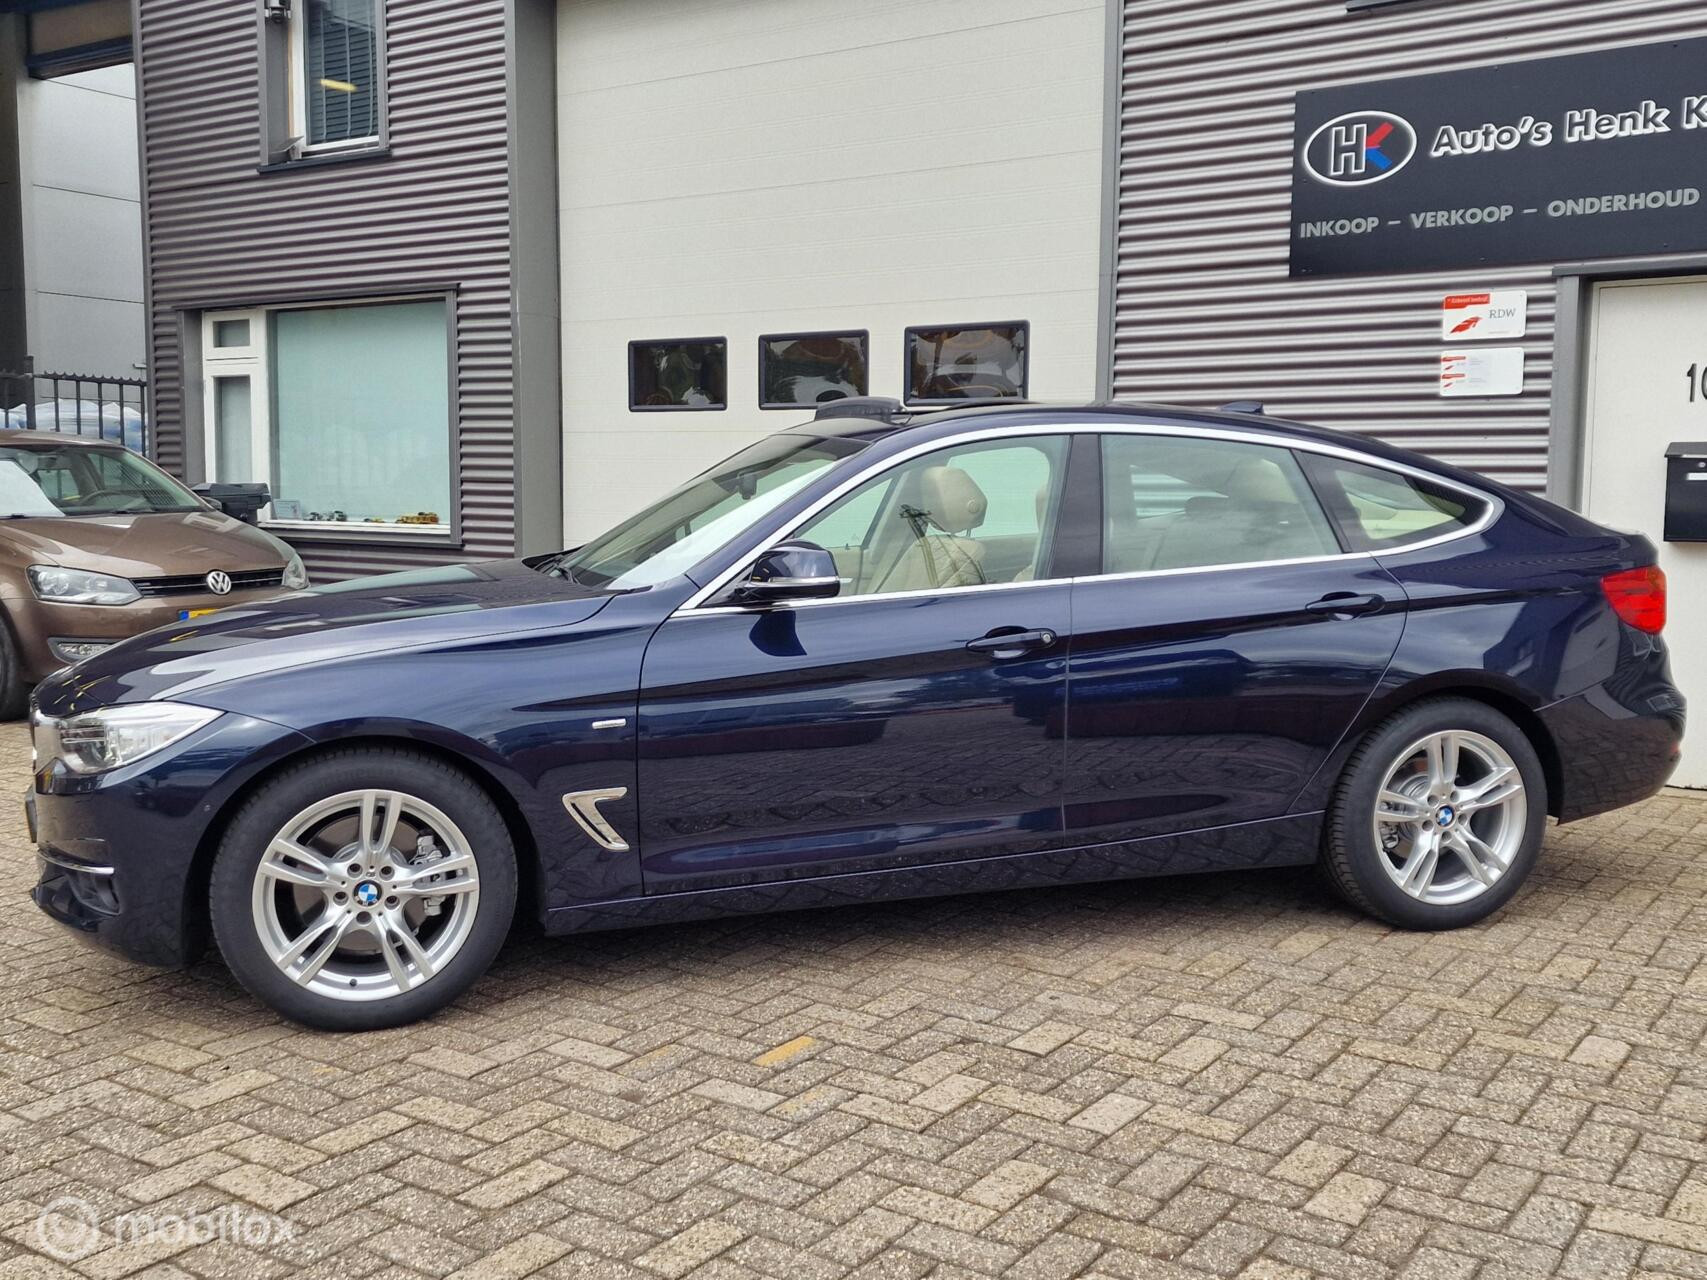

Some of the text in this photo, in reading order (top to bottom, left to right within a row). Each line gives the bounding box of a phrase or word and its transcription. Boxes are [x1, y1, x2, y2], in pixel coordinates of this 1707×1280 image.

[1429, 116, 1553, 158] Auto's
[1564, 100, 1670, 143] Henk
[1300, 216, 1380, 239] INKOOP
[1410, 204, 1514, 230] VERKOOP
[1547, 187, 1700, 217] ONDERHOUD
[1489, 308, 1517, 319] RDW
